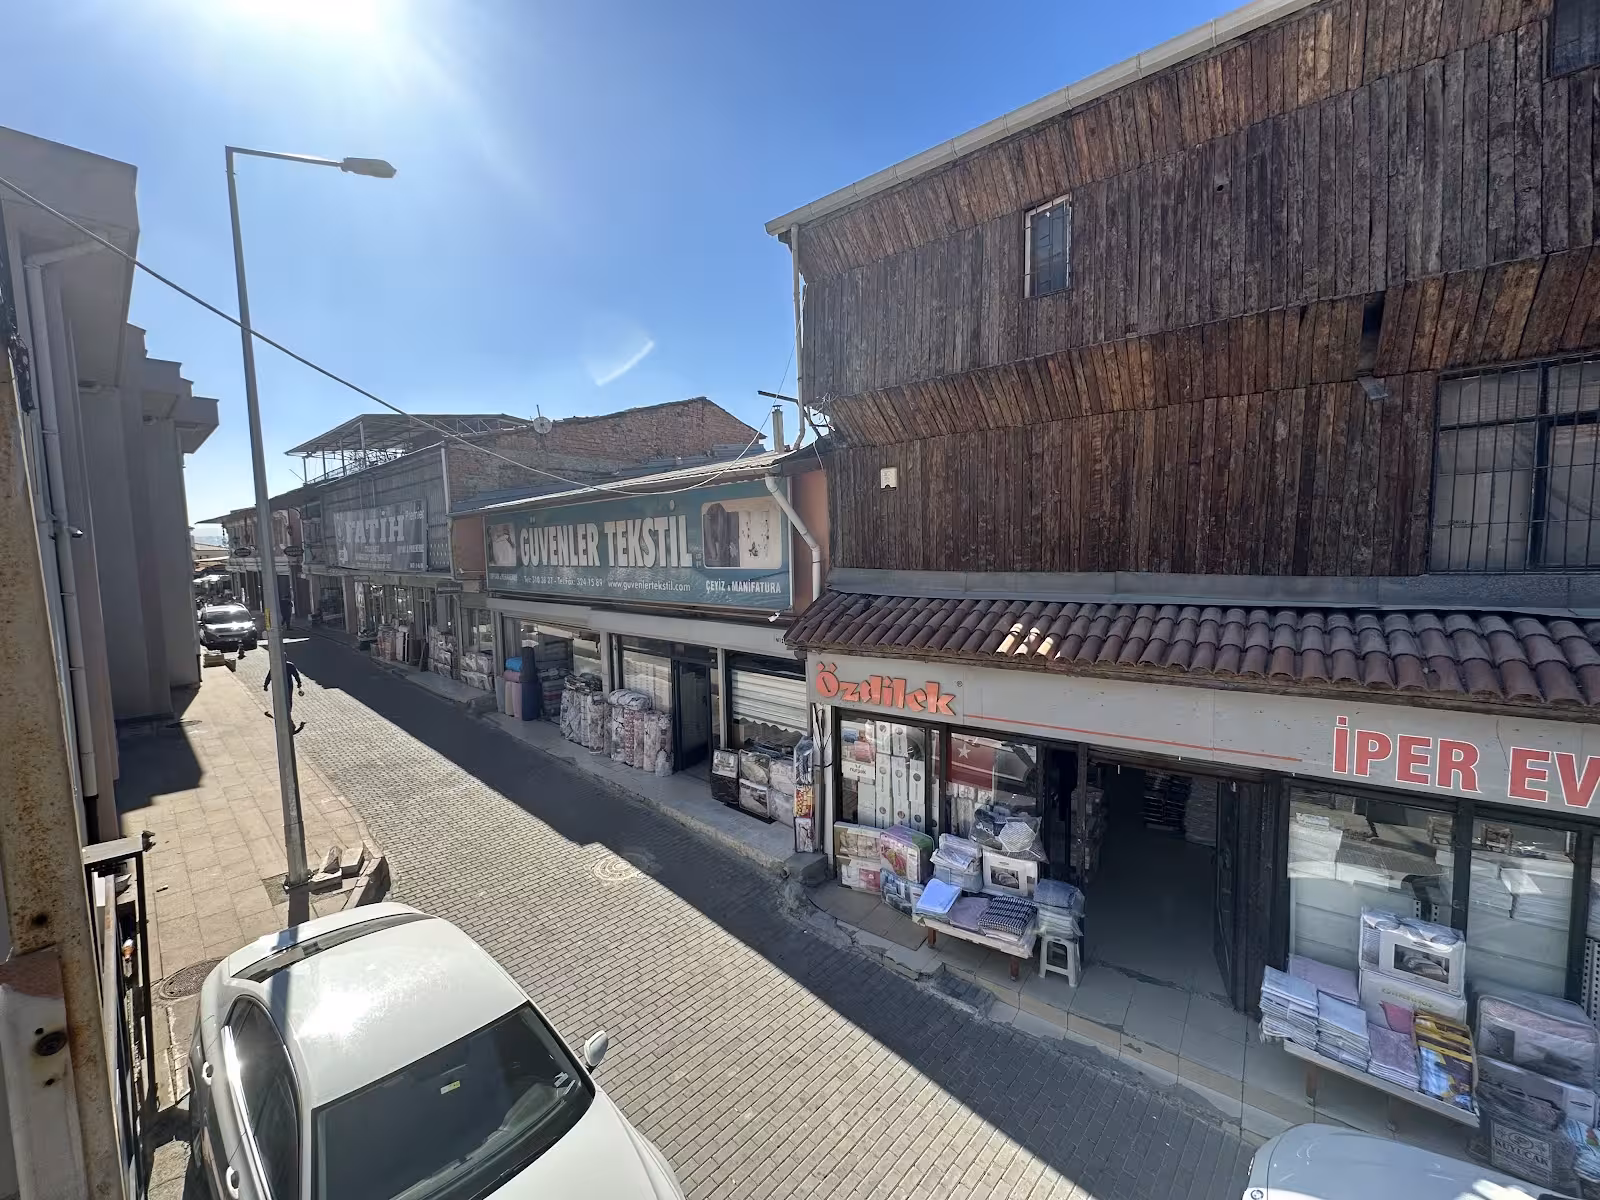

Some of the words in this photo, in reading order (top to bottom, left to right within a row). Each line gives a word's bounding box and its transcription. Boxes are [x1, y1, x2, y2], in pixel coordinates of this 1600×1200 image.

[344, 511, 405, 543] FATİH
[519, 516, 601, 568] GÜVENLER
[603, 500, 693, 568] TEKSTİL
[607, 578, 691, 592] www.guvenlertekstil.com
[705, 578, 726, 593] ÇEYİZ
[731, 579, 782, 594] MANİFATURA
[815, 660, 957, 716] Özdilek
